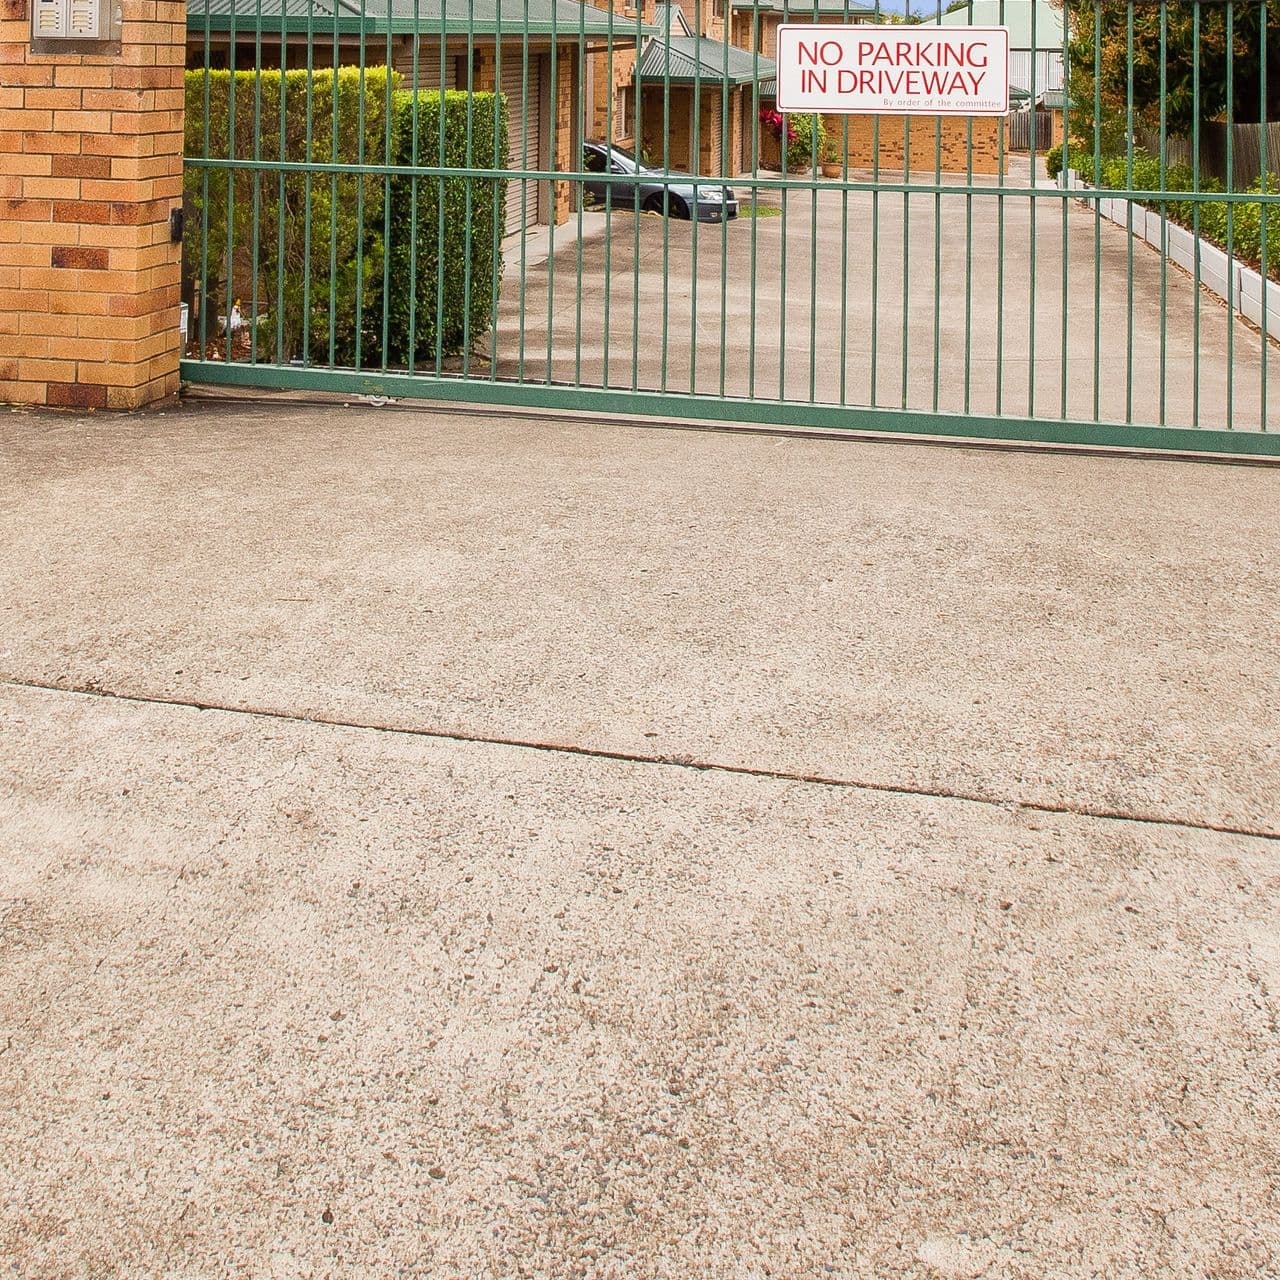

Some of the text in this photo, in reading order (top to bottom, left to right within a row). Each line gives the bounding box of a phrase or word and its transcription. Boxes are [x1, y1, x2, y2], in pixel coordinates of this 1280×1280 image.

[797, 40, 988, 68] NO PARKING
[800, 69, 987, 96] IN DRIVEWAY
[883, 98, 1001, 109] By order of the committee
